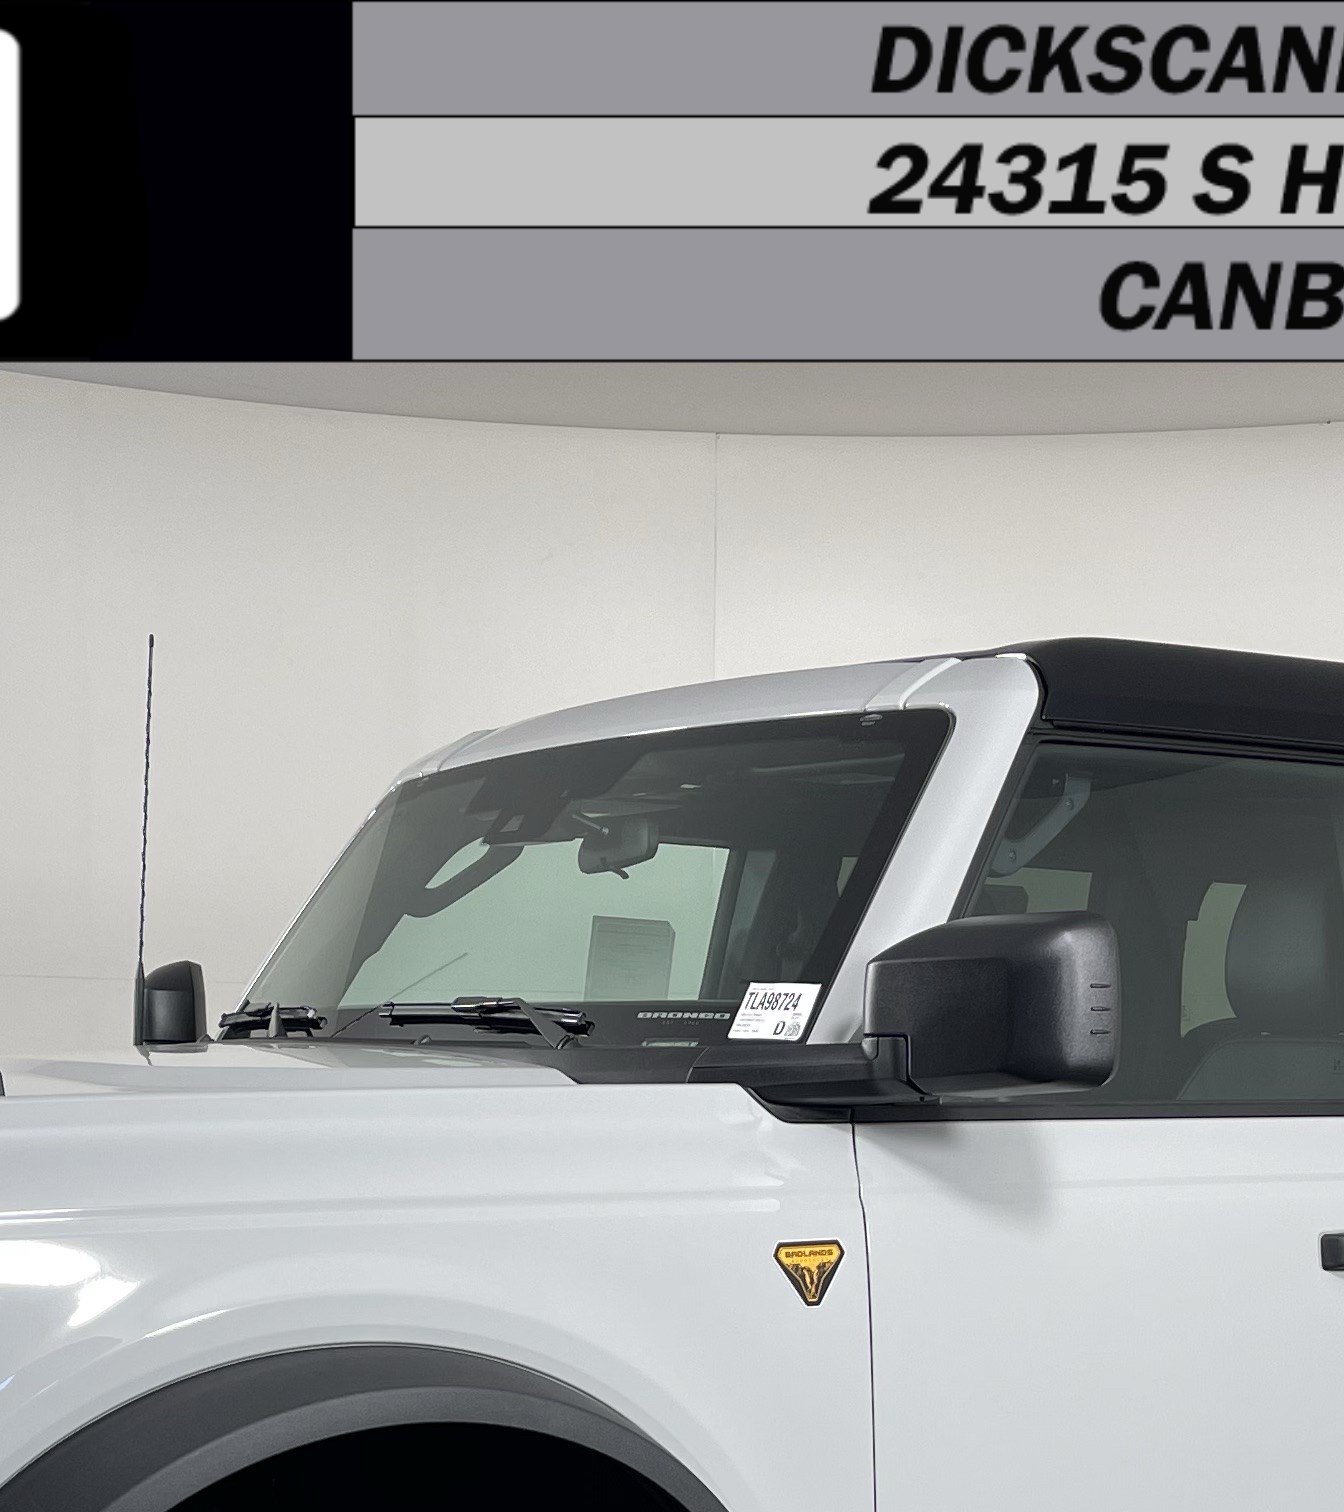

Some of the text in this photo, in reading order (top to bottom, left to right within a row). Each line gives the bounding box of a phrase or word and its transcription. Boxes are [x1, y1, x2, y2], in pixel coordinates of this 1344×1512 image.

[744, 991, 802, 1011] TLA98724
[636, 1011, 731, 1020] BRONCO
[772, 1020, 786, 1036] D
